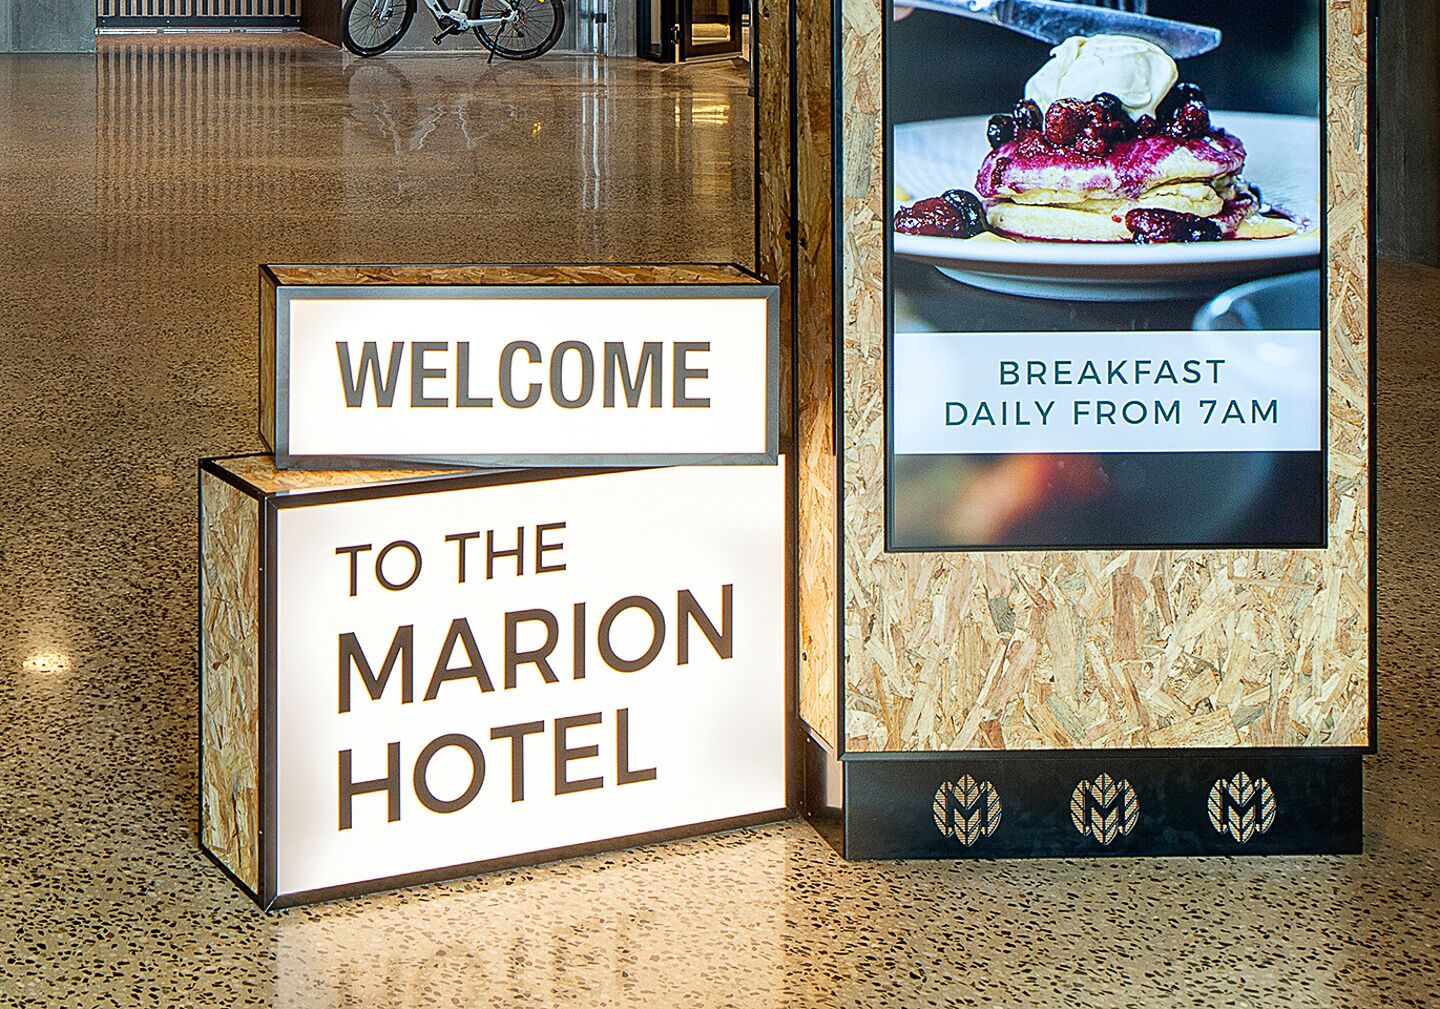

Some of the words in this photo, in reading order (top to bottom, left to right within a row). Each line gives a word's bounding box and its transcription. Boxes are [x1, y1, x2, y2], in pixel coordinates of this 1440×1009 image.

[335, 340, 711, 410] WELCOME
[1000, 359, 1226, 386] BREAKFAST
[945, 400, 1055, 426] DAILY
[1073, 400, 1180, 425] FROM
[1199, 399, 1279, 425] 7AM
[335, 539, 423, 598] TO
[444, 521, 567, 584] THE
[338, 584, 734, 714] MARION
[338, 707, 658, 831] HOTEL
